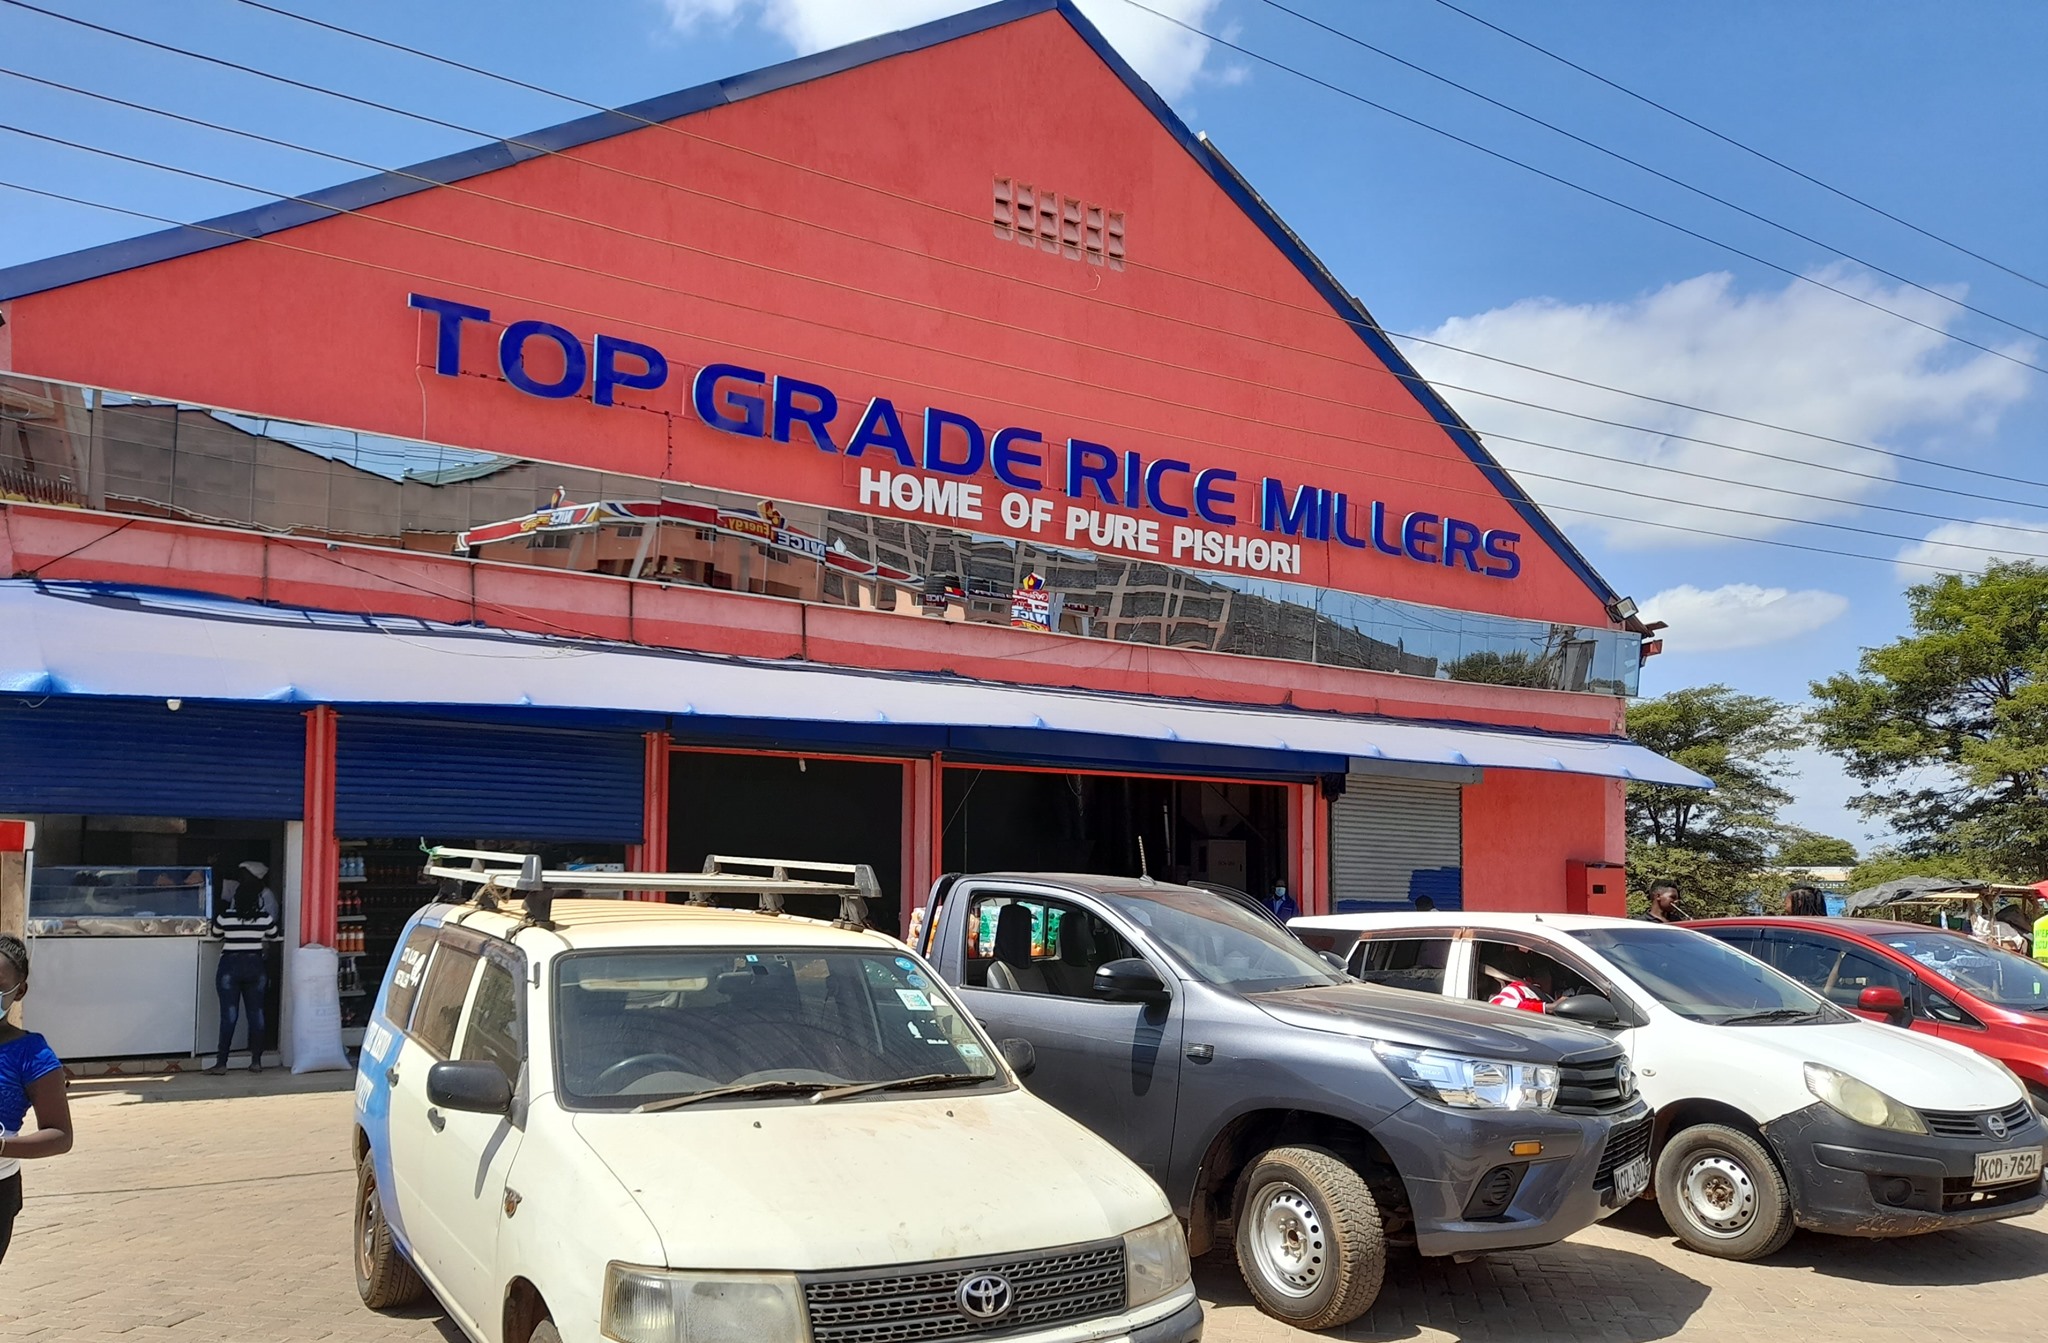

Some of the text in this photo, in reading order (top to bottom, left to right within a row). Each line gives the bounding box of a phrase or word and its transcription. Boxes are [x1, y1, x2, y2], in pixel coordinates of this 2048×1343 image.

[407, 292, 1522, 580] TOP GRADE RICE MILLERS
[858, 466, 1301, 575] HOME OF PURE PISHORI
[1978, 1153, 2039, 1181] KCD 762L
